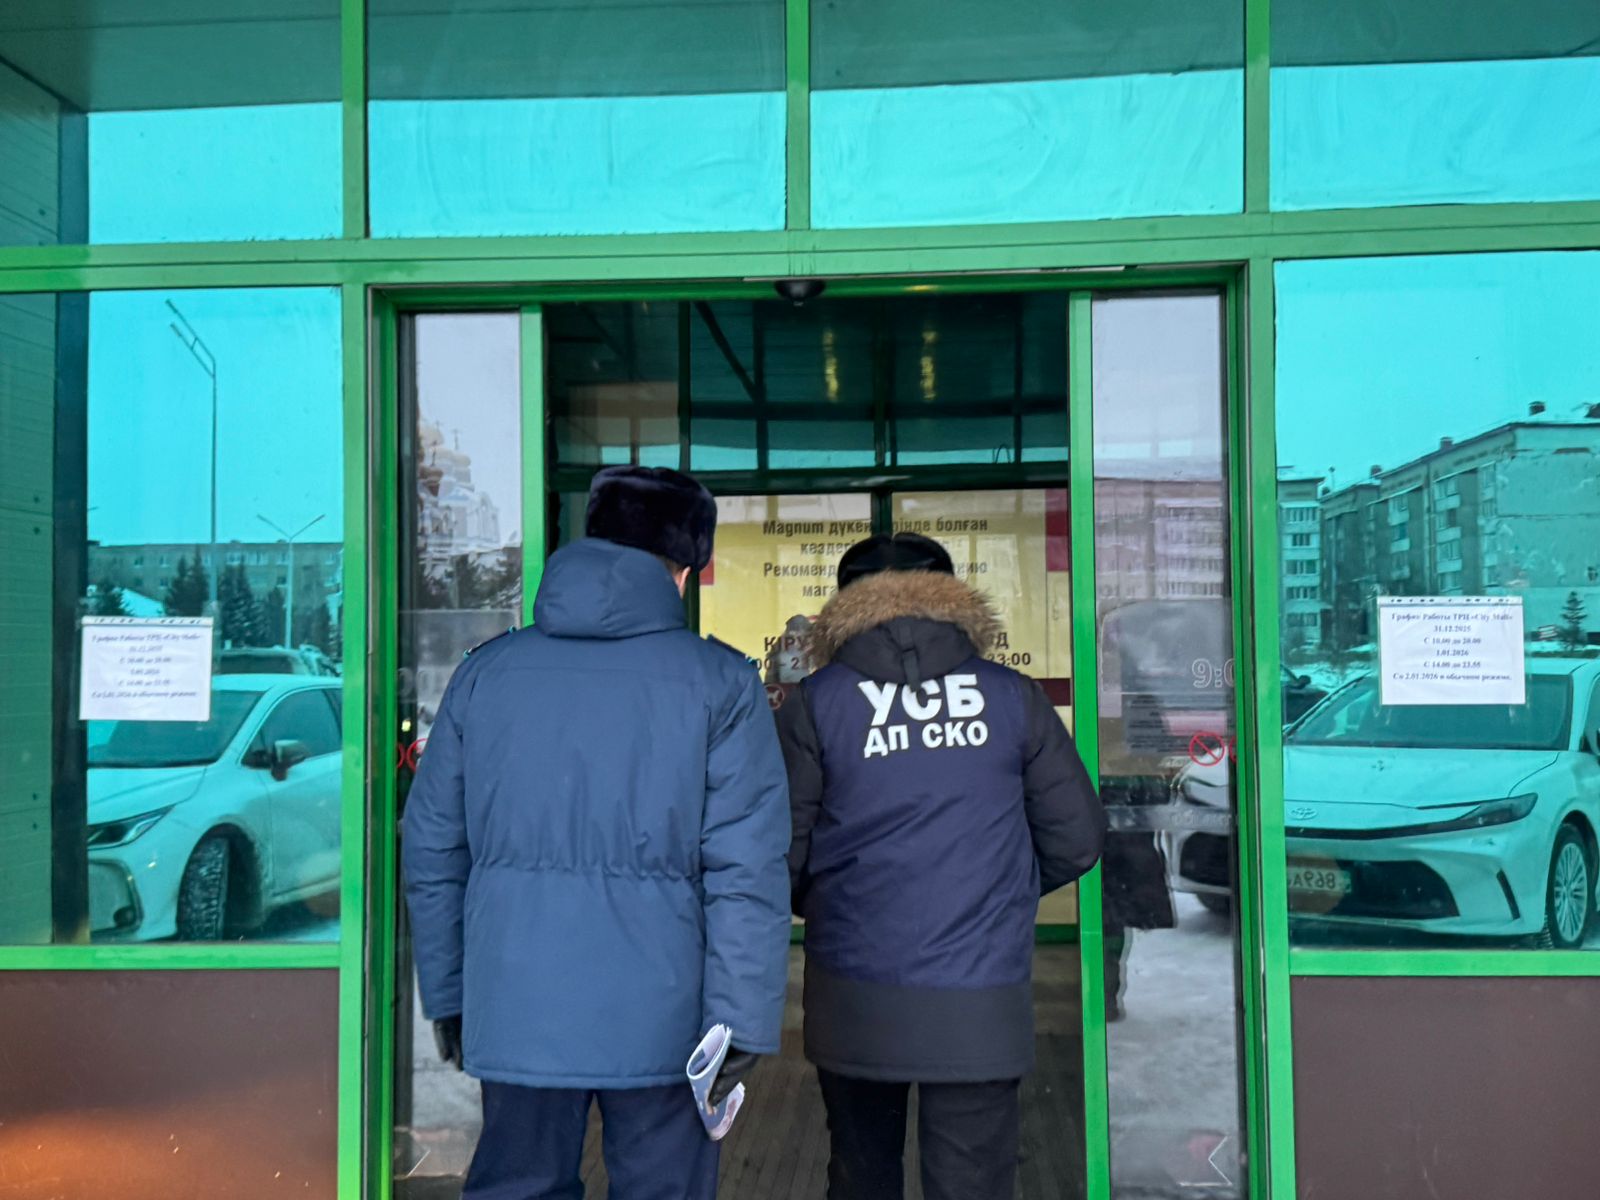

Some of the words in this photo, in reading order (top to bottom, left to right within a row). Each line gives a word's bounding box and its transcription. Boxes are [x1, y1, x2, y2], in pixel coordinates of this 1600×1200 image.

[763, 520, 823, 536] Magnum
[936, 516, 987, 532] болған
[764, 562, 837, 578] Рекоменд
[857, 673, 985, 726] УСБ
[864, 724, 909, 758] ДП
[921, 720, 988, 748] СКО
